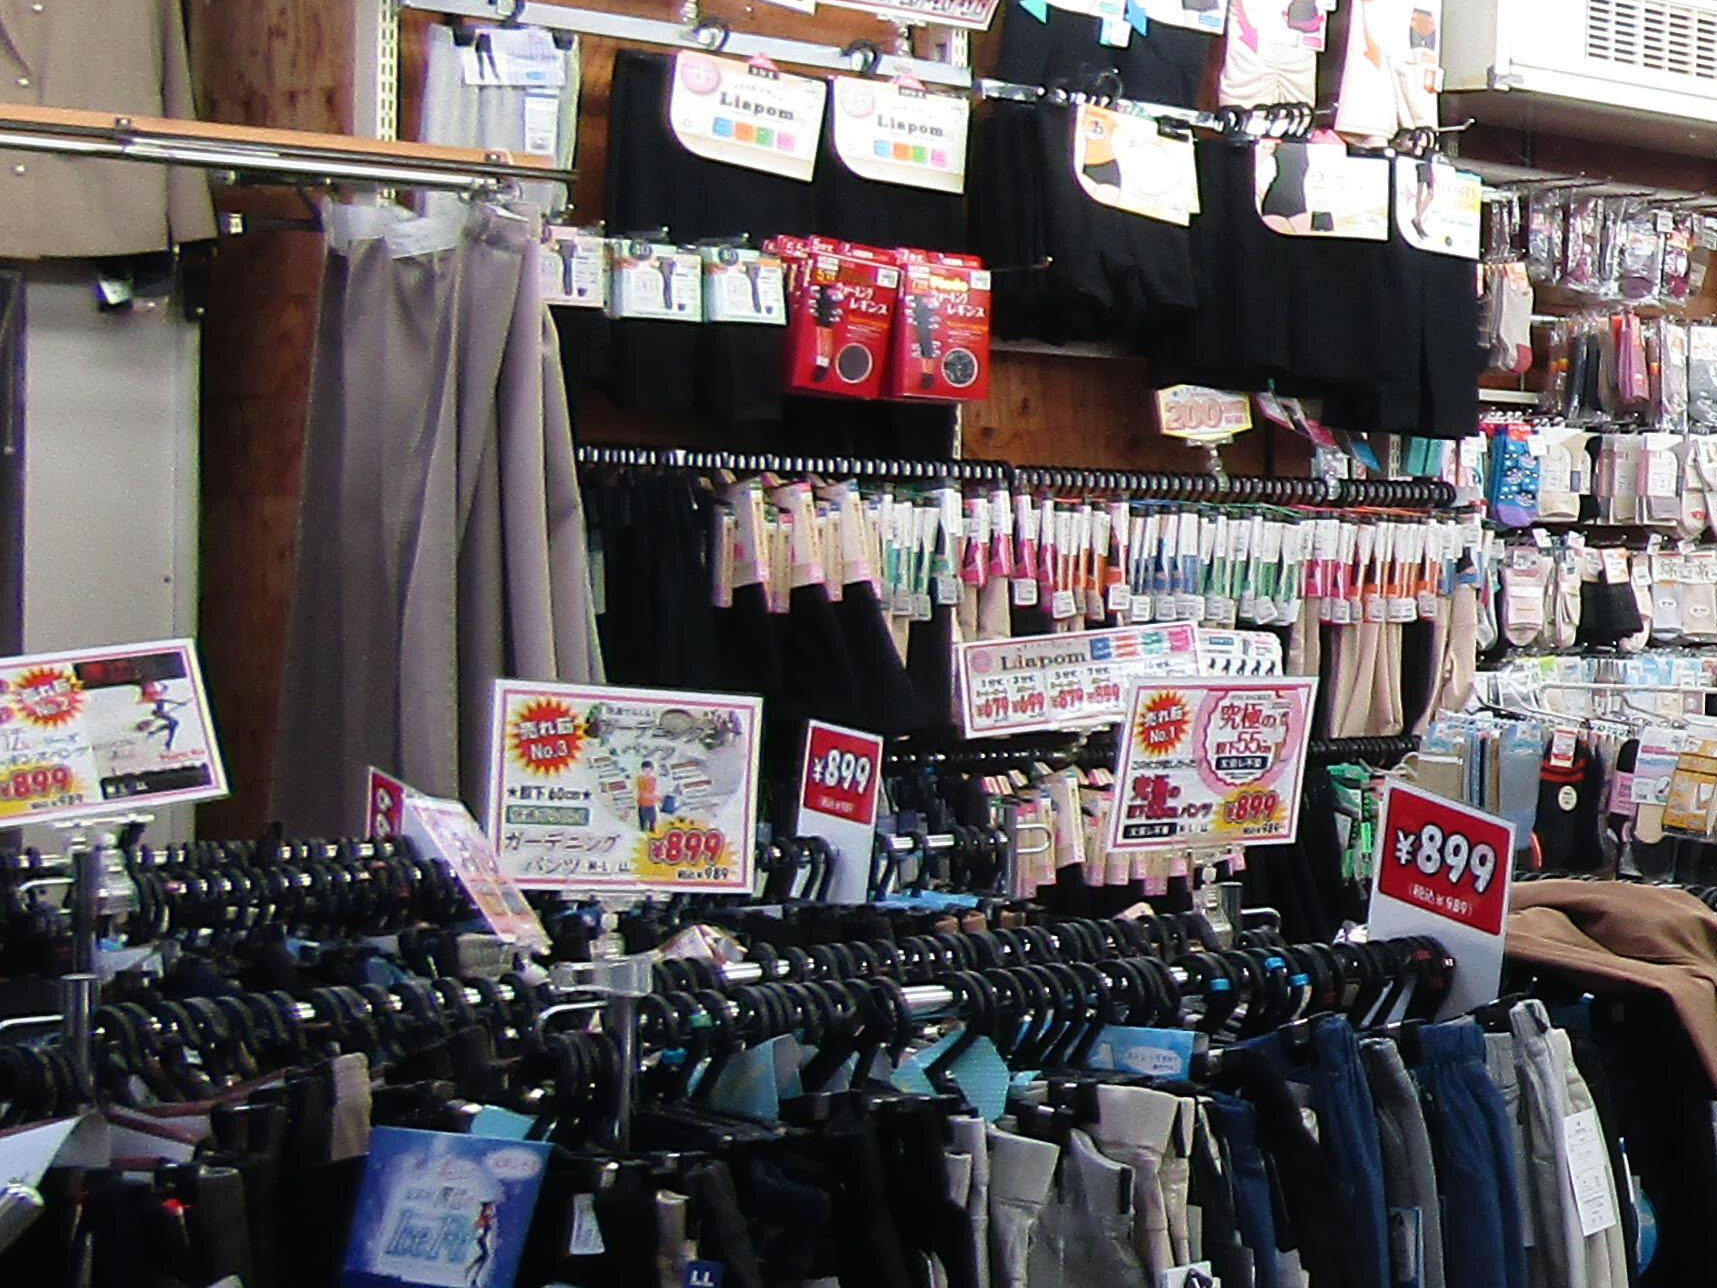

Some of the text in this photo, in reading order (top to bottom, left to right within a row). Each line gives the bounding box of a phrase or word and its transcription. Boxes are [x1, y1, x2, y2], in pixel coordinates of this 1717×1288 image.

[1000, 650, 1088, 671] Liapom
[530, 741, 569, 760] No.3
[812, 748, 871, 794] ¥899
[1223, 789, 1280, 824] ¥899
[504, 832, 621, 853] ガーデニング
[650, 827, 725, 866] ¥899
[526, 857, 580, 875] パンツ
[1394, 823, 1496, 894] ¥899
[689, 1268, 716, 1288] LL
